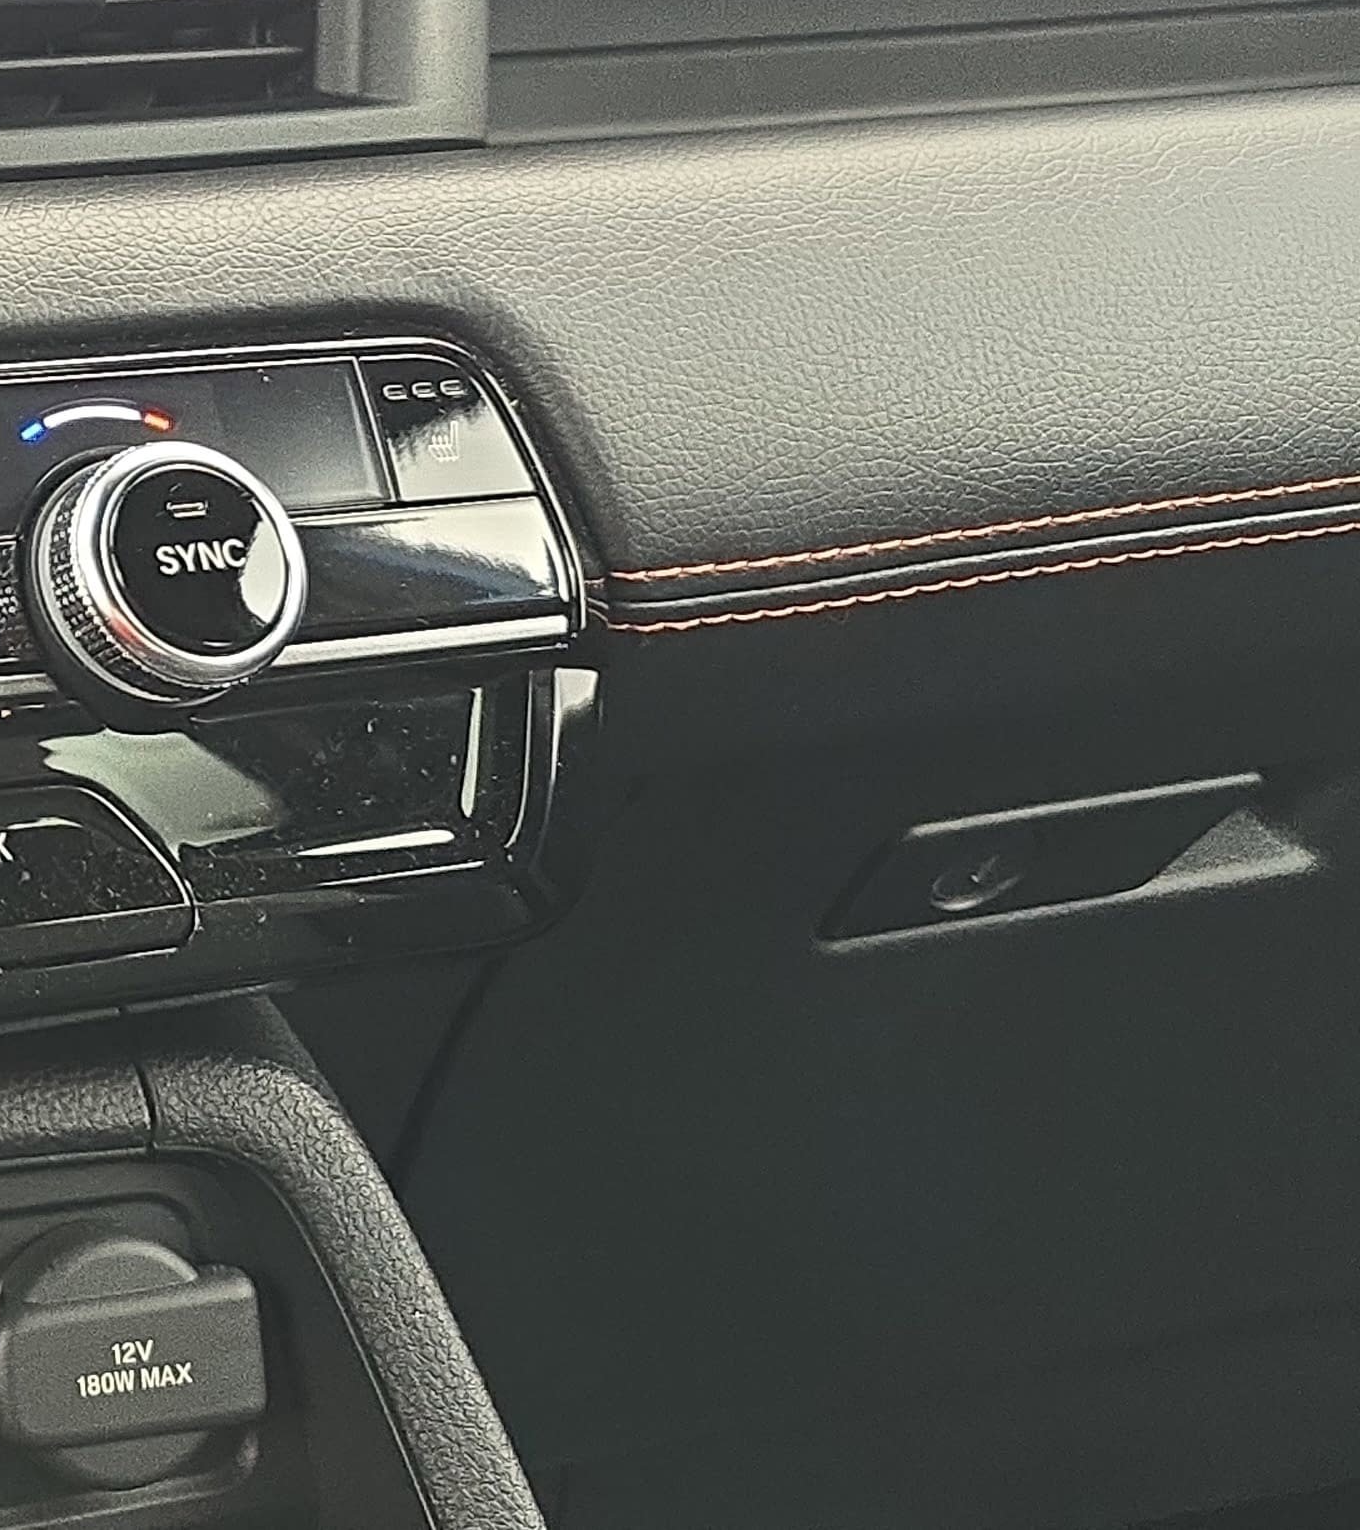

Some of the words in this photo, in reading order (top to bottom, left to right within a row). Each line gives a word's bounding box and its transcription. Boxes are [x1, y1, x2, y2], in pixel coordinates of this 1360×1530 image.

[156, 538, 246, 575] SYNC
[111, 1339, 154, 1365] 12V
[77, 1367, 135, 1398] 180W
[140, 1360, 193, 1389] MAX
